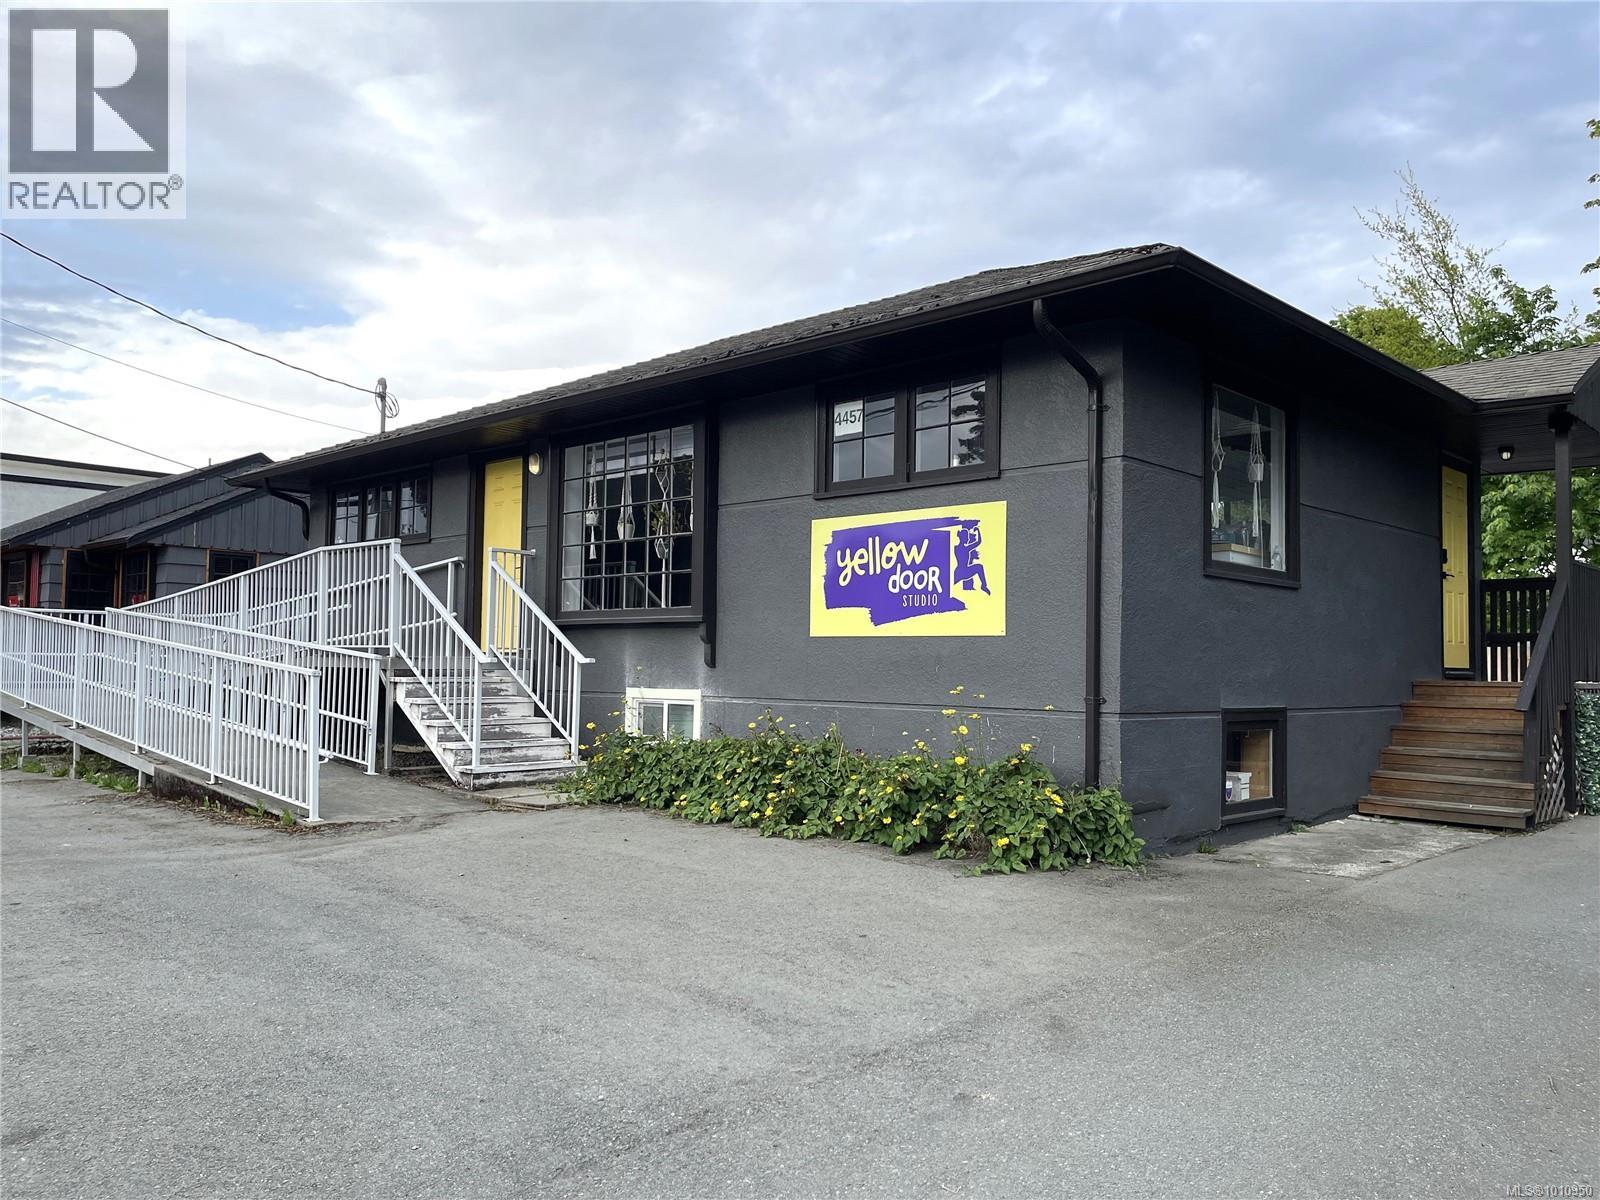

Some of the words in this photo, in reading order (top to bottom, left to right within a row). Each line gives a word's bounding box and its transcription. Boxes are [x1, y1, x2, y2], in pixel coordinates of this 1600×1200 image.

[834, 408, 863, 426] 4457
[836, 535, 929, 587] yellow
[902, 593, 939, 607] STUDIO
